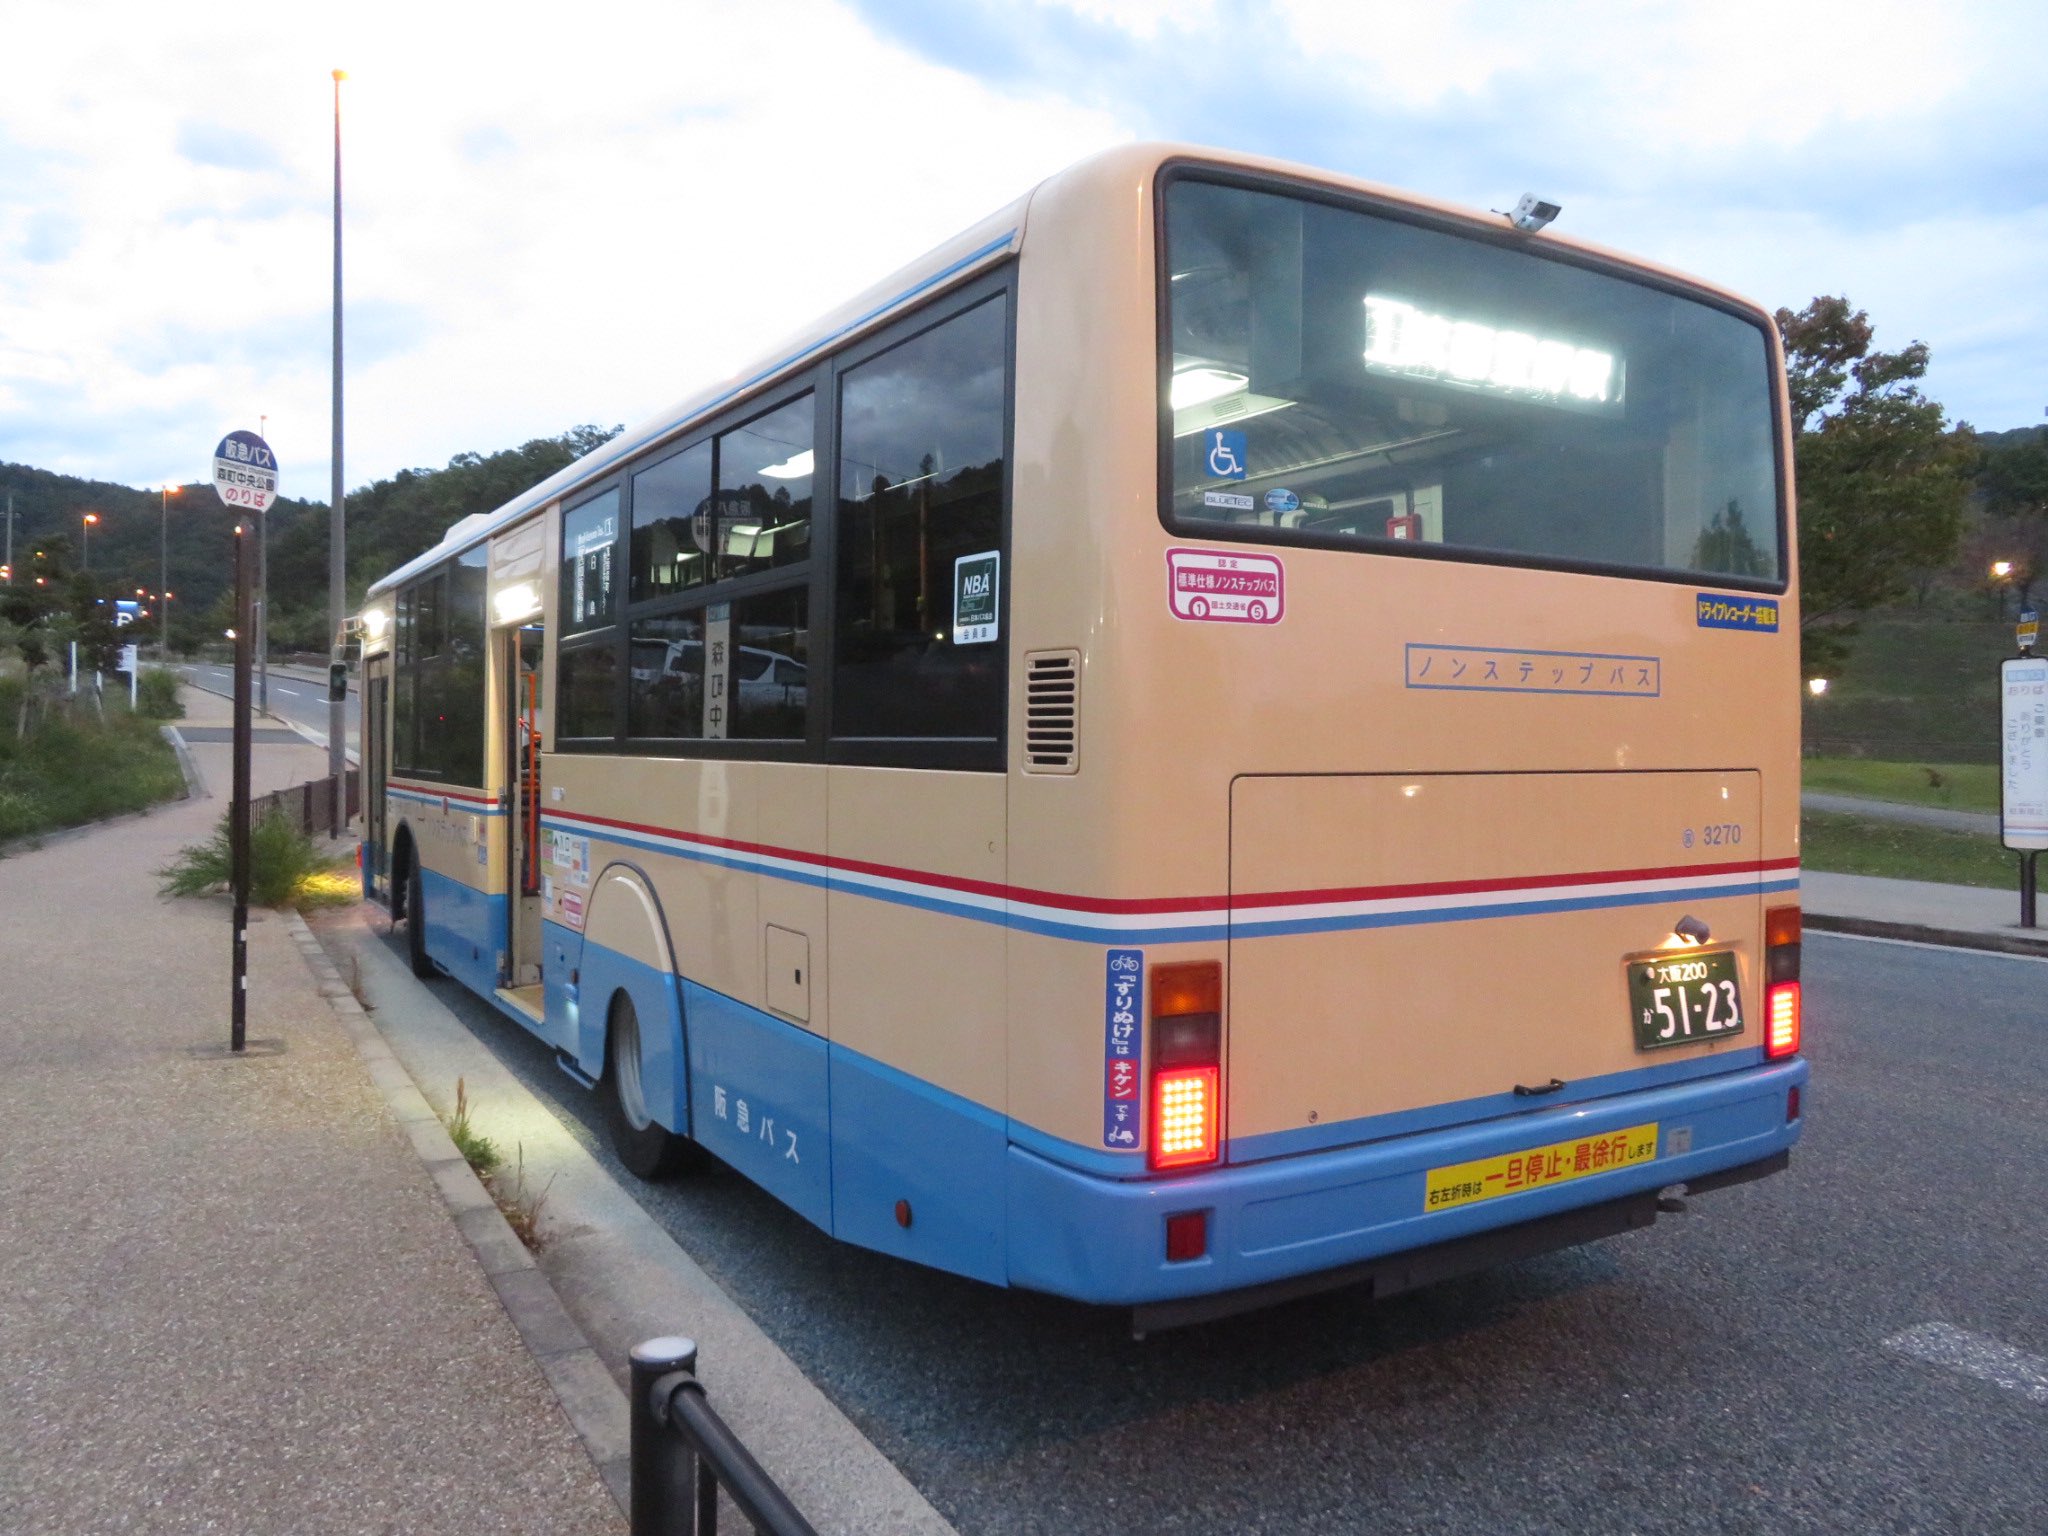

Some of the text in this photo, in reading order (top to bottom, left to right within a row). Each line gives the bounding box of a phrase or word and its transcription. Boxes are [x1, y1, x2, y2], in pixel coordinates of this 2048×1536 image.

[225, 438, 271, 467] 阪急バス
[226, 487, 266, 507] のりば
[1217, 558, 1238, 569] 認定
[963, 574, 990, 596] NBA
[1178, 572, 1276, 592] 標準仕様ノンステップバス
[1211, 600, 1247, 611] 国土交通省
[1419, 656, 1650, 687] ノンステップバス
[1703, 824, 1742, 846] 3270
[714, 1085, 800, 1165] 阪急バス
